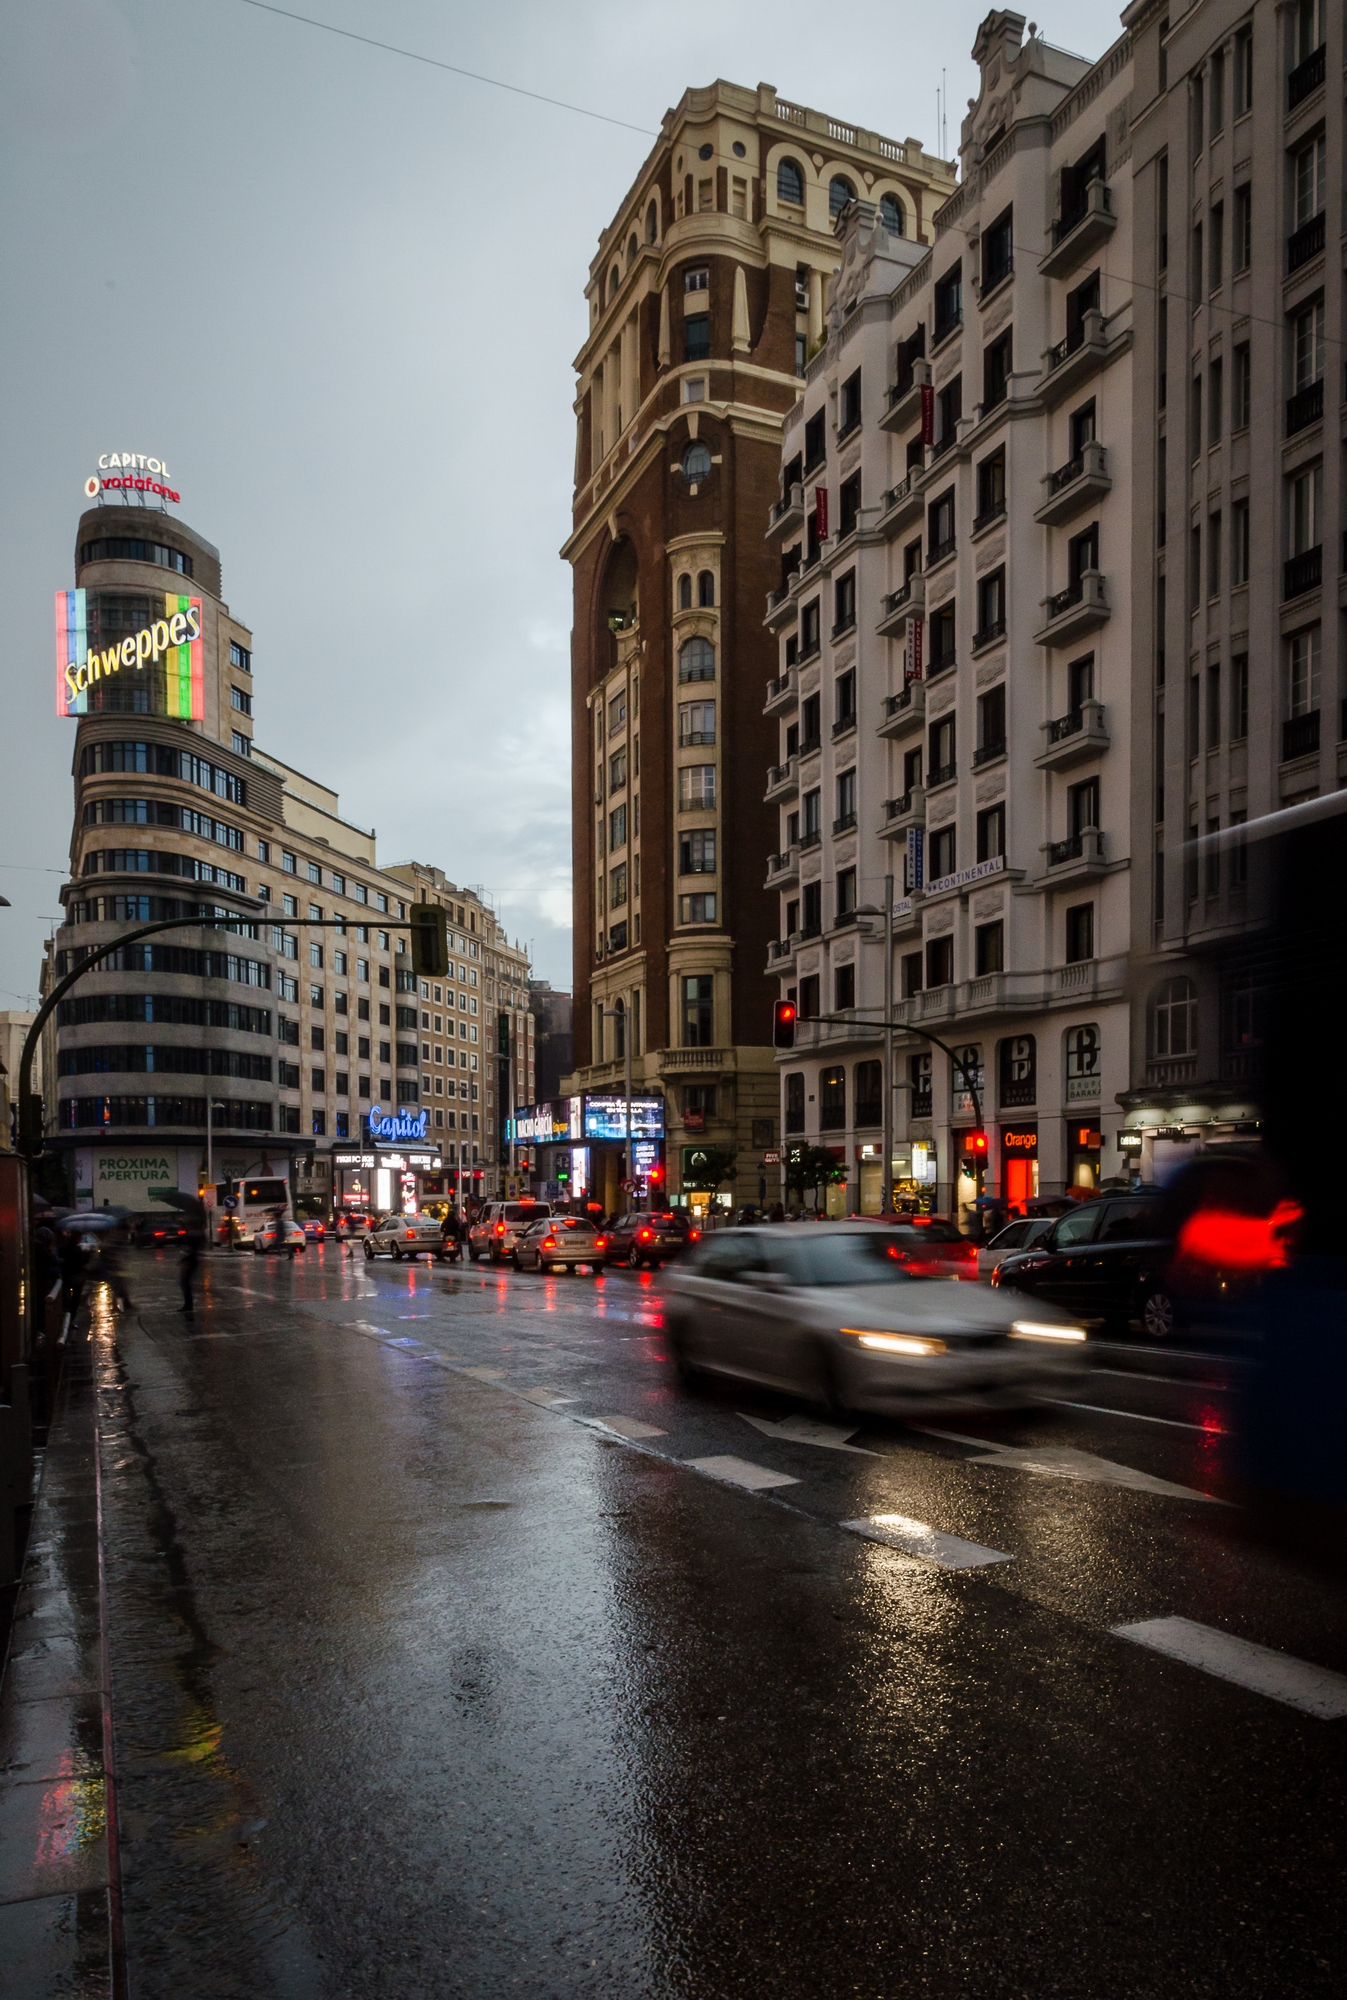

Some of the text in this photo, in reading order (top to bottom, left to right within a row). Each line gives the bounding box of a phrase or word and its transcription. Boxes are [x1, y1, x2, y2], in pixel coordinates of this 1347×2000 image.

[99, 453, 171, 478] CAPITOL
[101, 474, 181, 503] vodafone
[64, 605, 201, 705] Schweppes
[938, 860, 1001, 891] CONTINENTAL
[369, 1106, 427, 1141] Capitol
[1005, 1132, 1037, 1149] Orange
[99, 1156, 170, 1169] PRÓXIMA
[99, 1170, 170, 1180] APERTURA
